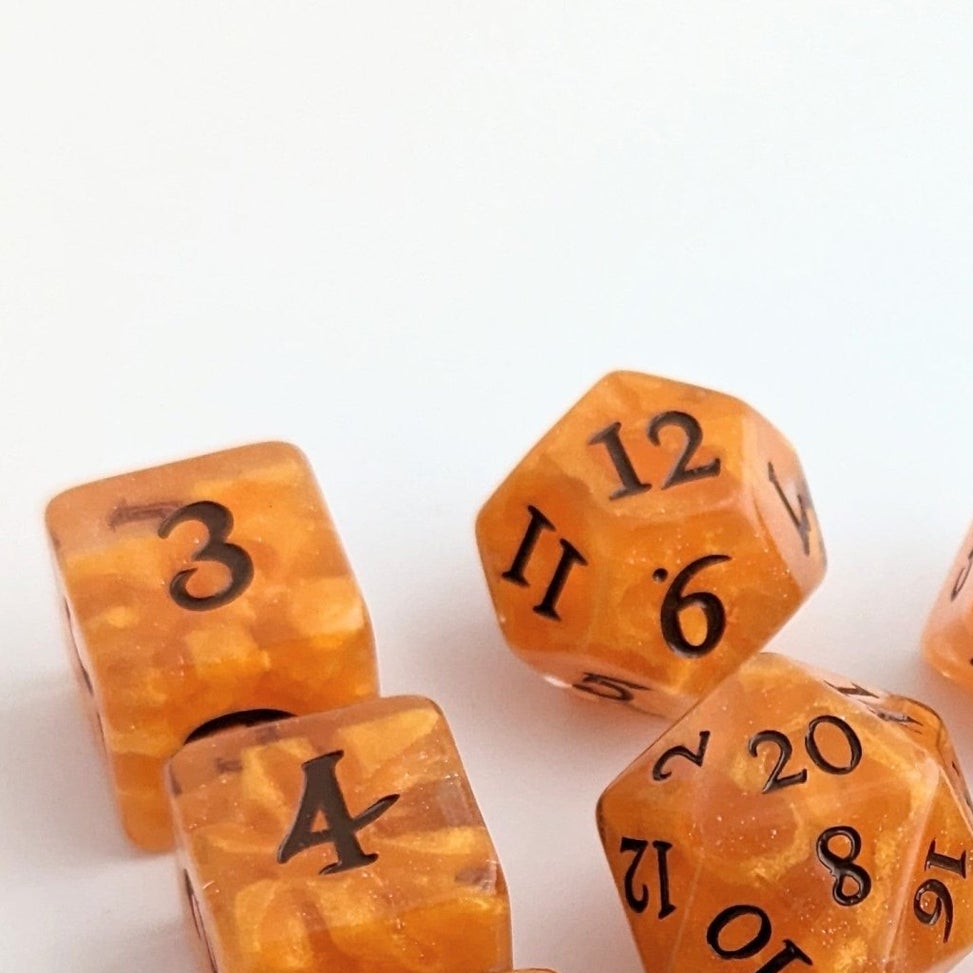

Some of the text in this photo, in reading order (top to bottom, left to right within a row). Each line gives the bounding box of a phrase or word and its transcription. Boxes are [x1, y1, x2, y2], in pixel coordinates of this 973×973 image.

[588, 409, 722, 500] 12
[158, 499, 255, 612] 3
[501, 505, 585, 619] 11
[571, 671, 653, 702] 5
[652, 730, 710, 781] 2
[748, 714, 863, 793] 20
[277, 749, 401, 876] 4
[619, 836, 676, 919] 12
[815, 825, 872, 907] 8
[913, 840, 967, 942] 16
